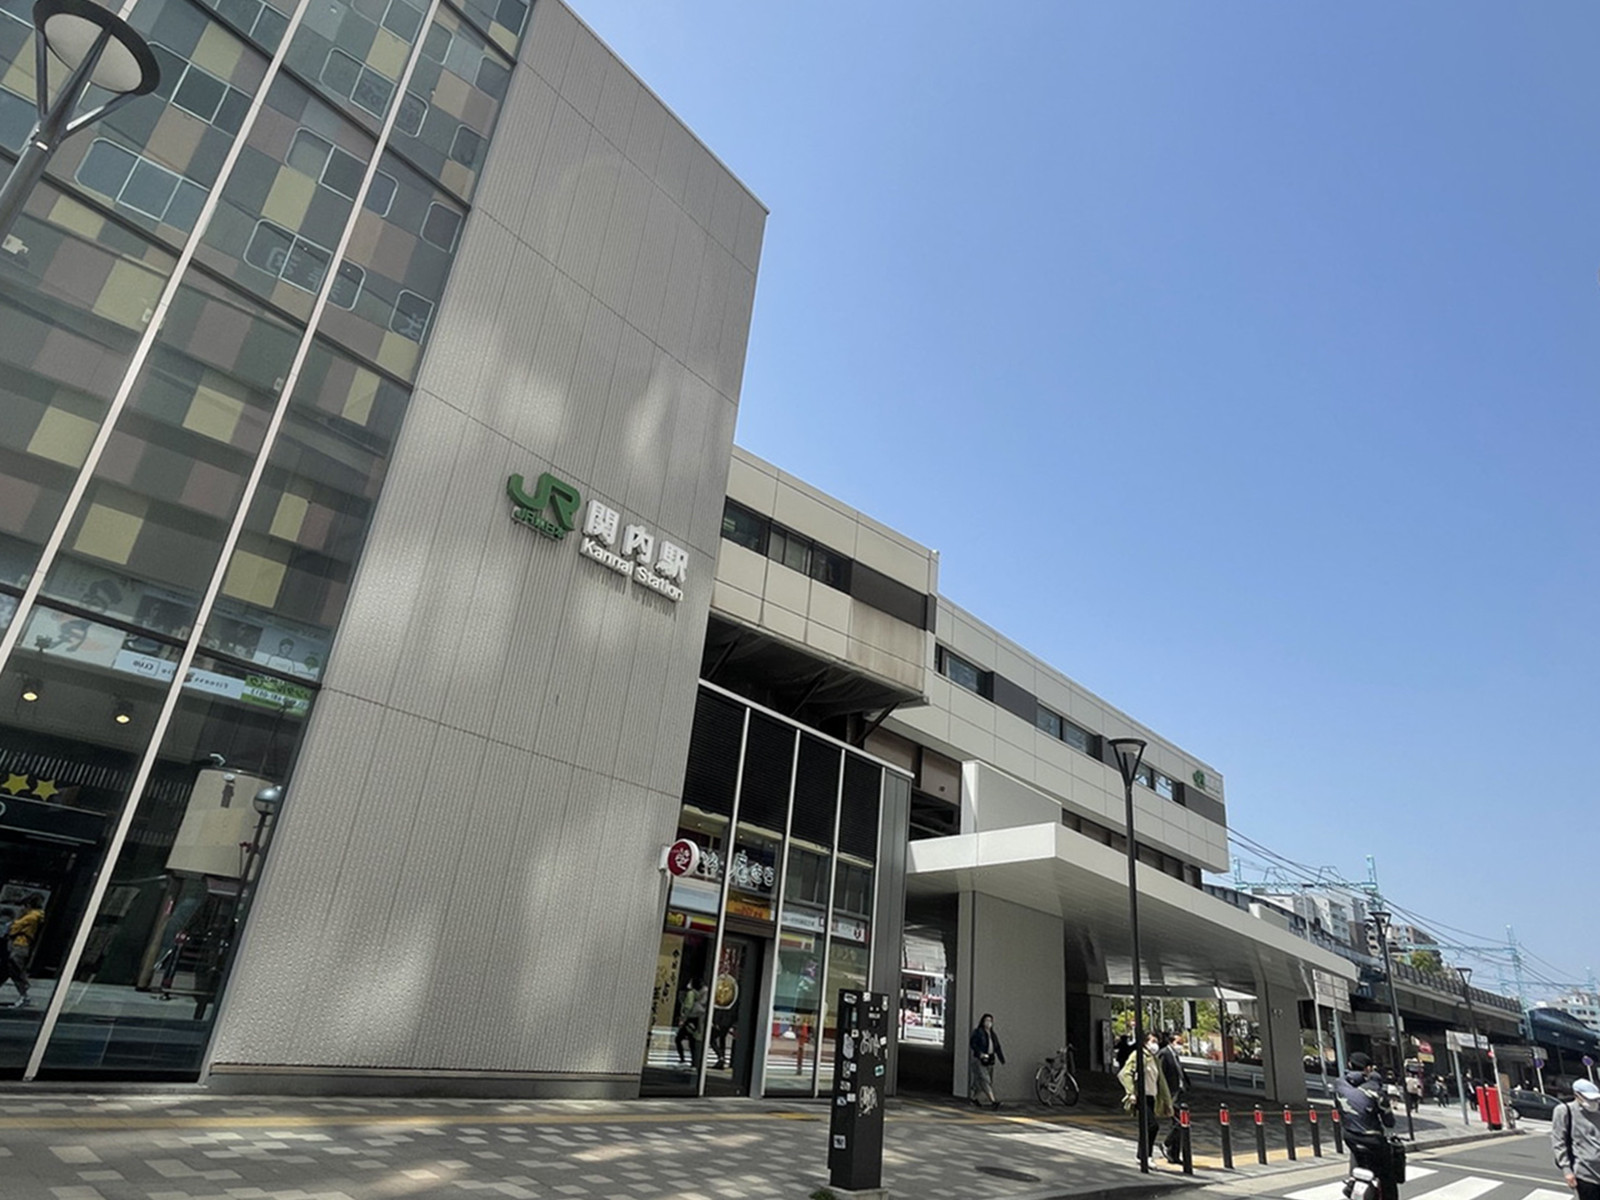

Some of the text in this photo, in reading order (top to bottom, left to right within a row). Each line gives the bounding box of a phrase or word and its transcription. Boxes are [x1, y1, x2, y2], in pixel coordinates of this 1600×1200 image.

[507, 472, 581, 531] JR
[581, 537, 684, 601] Kannai Station
[582, 499, 689, 584] 関内駅
